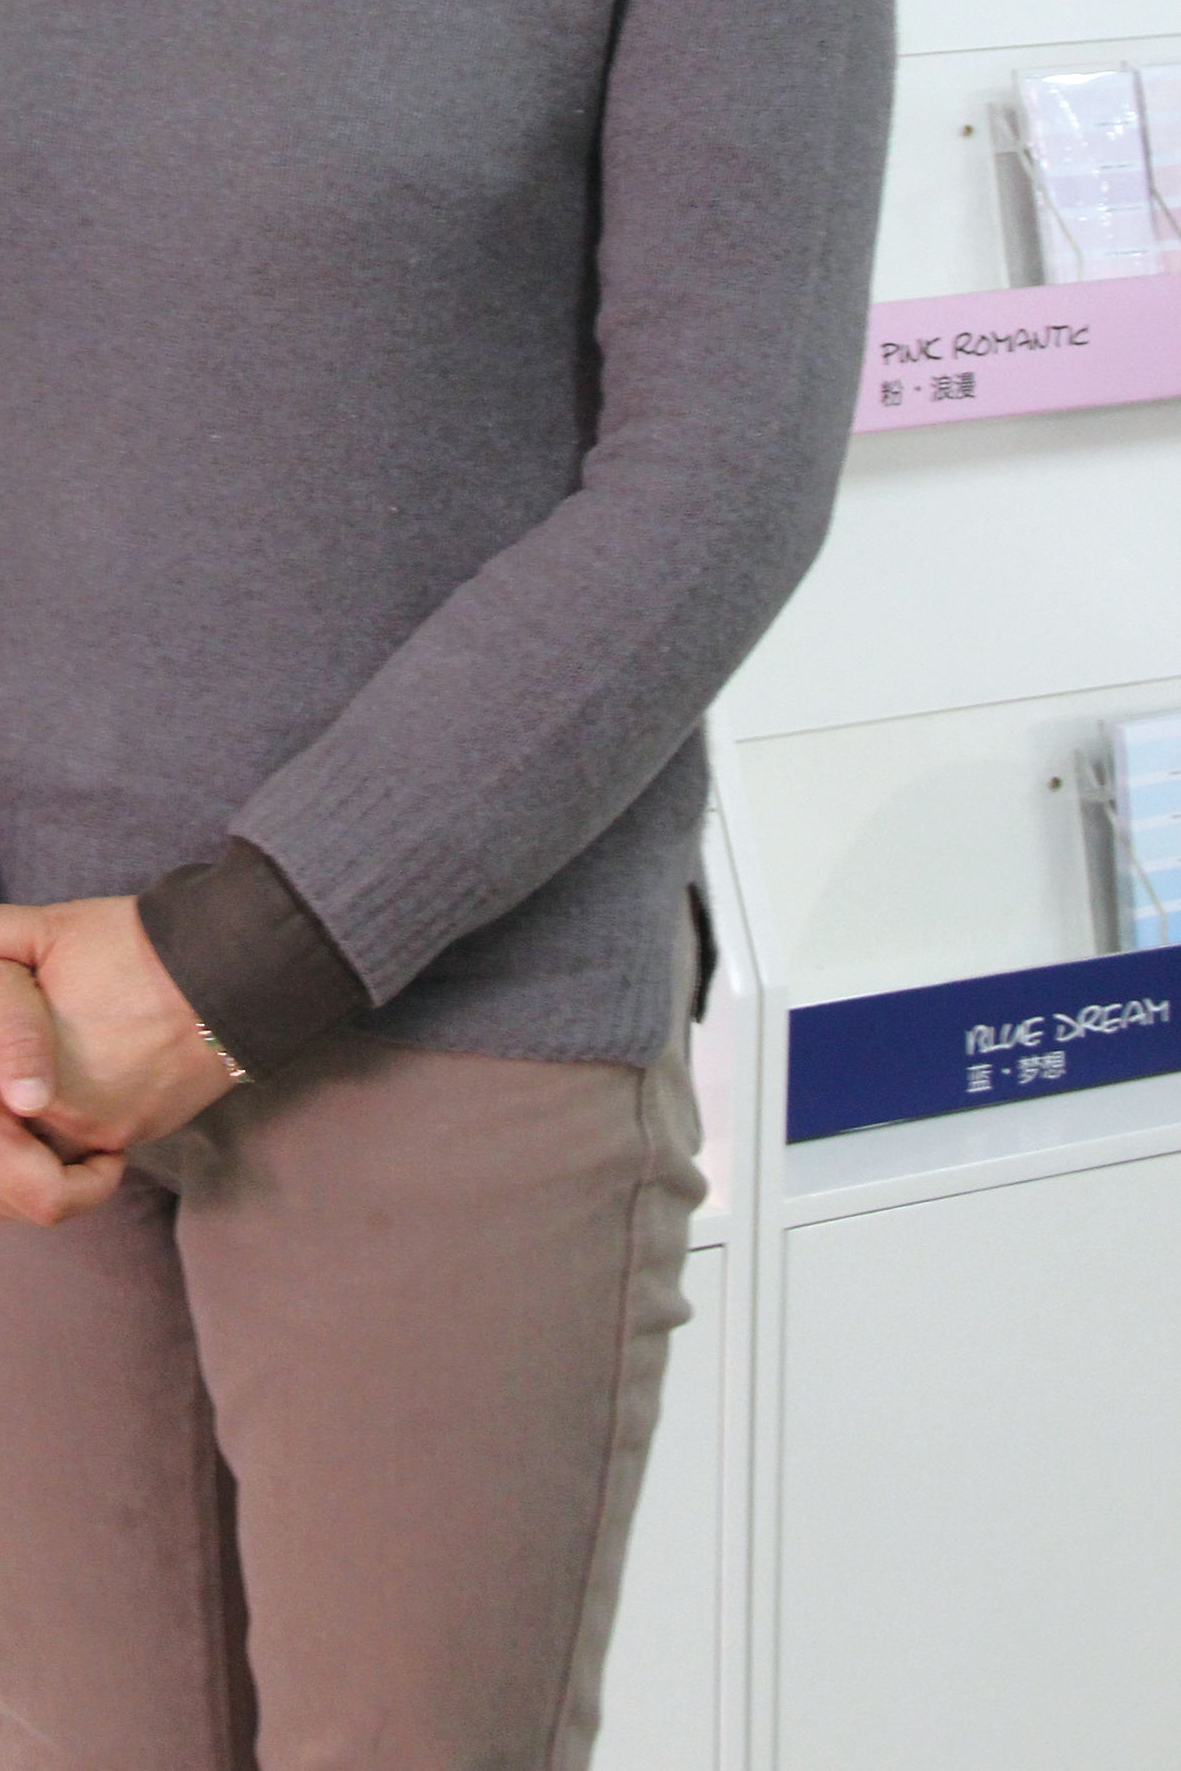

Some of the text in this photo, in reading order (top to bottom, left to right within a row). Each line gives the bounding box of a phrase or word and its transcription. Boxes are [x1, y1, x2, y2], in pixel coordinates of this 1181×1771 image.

[880, 324, 1090, 365] PINK ROMANTIC
[965, 998, 1171, 1055] BLUE DREAM
